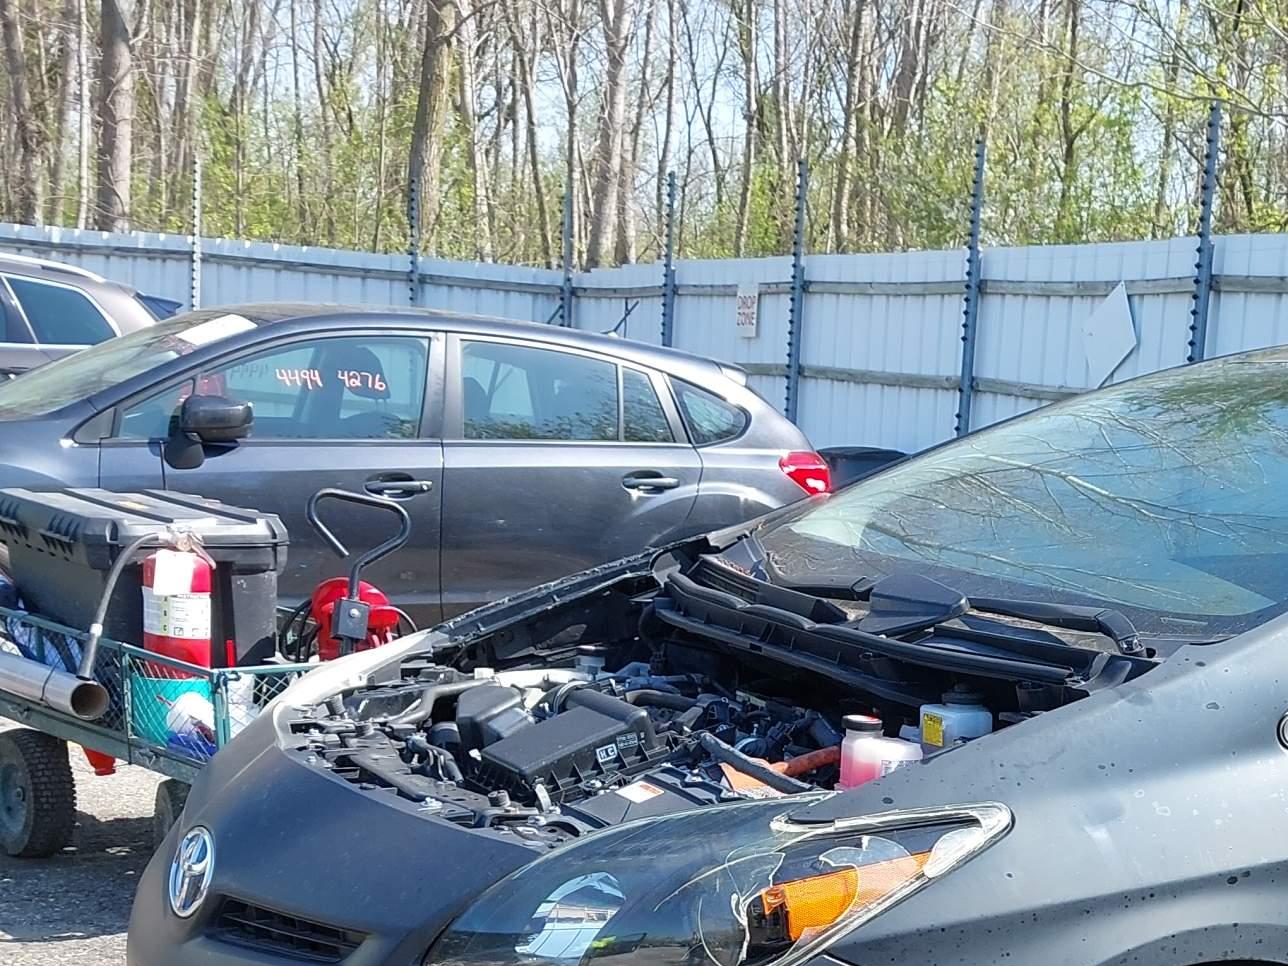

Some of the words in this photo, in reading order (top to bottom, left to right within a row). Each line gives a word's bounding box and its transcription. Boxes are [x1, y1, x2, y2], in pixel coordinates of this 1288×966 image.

[736, 295, 757, 310] DROP
[736, 311, 756, 326] ZONE
[275, 368, 324, 390] 4494
[336, 369, 387, 392] 4276
